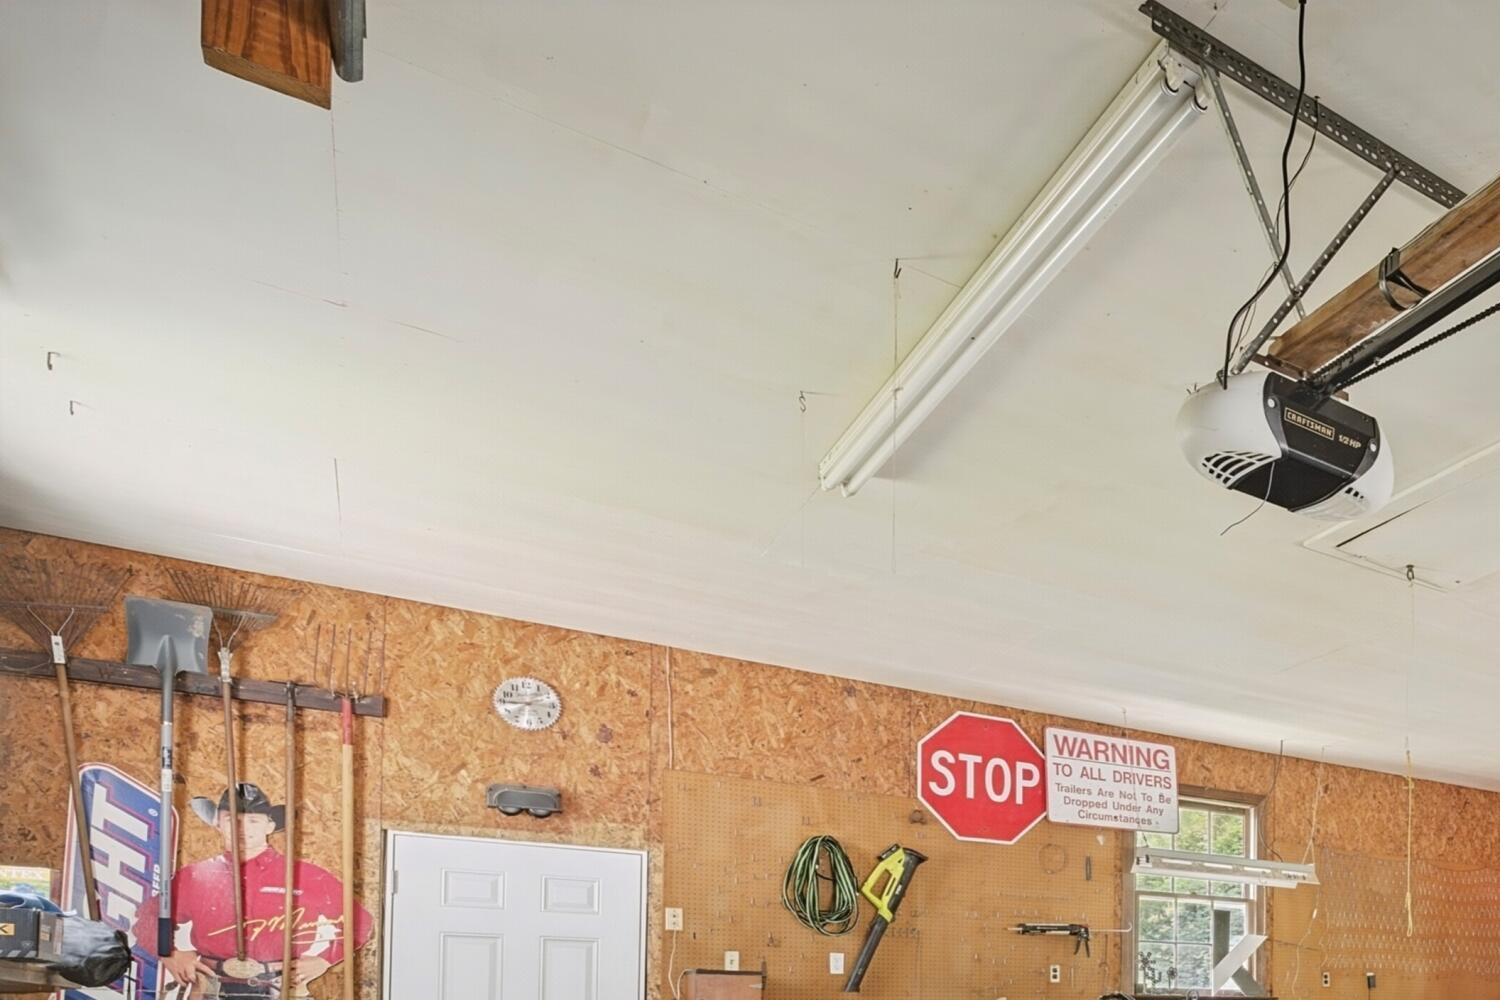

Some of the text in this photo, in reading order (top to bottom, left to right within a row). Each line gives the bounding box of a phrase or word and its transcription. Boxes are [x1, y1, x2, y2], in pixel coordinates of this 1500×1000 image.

[1286, 411, 1333, 437] CRAFTSMAN
[511, 684, 519, 692] 11
[1053, 734, 1170, 770] WARNING
[928, 749, 1040, 805] STOP
[1052, 762, 1172, 790] TO ALL DRIVERS
[1055, 783, 1172, 804] Trailers Are Not To Be
[1063, 796, 1164, 816] Dropped Under Any
[1078, 809, 1152, 826] Circumstances
